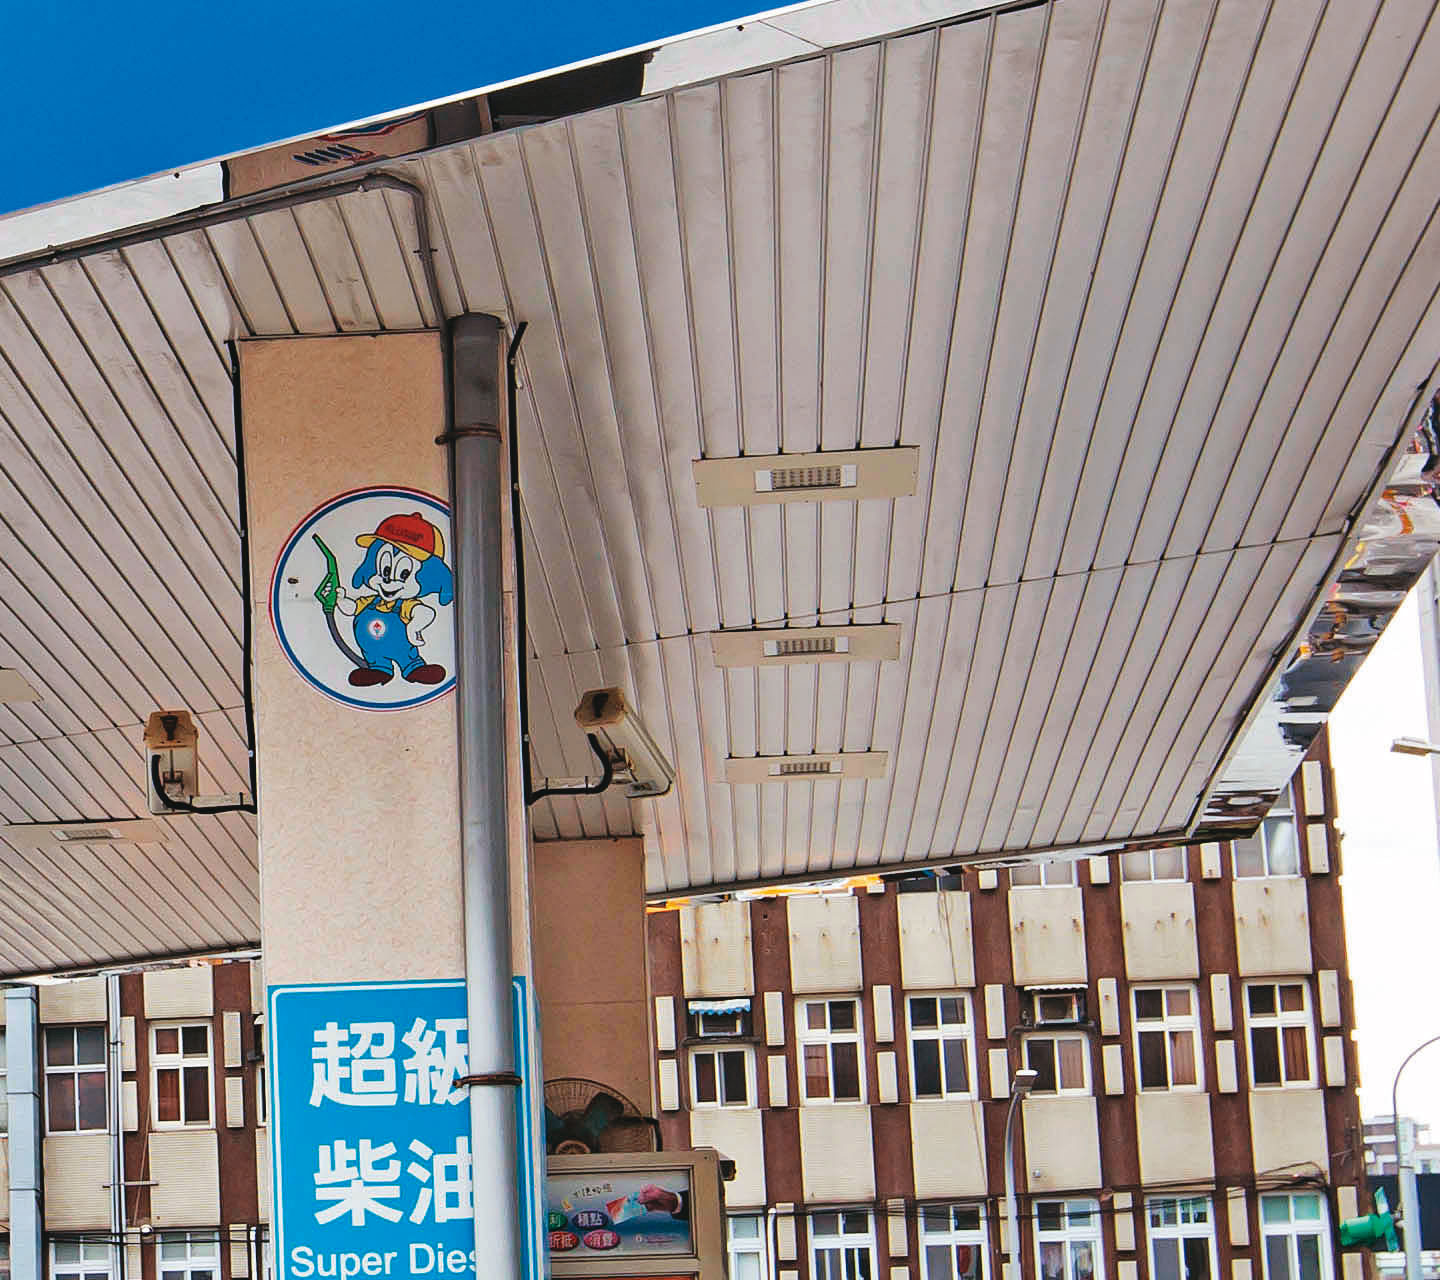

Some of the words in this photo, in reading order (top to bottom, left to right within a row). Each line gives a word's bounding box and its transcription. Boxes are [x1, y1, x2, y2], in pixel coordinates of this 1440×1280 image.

[308, 1017, 470, 1108] 超級
[313, 1135, 475, 1227] 柴油
[408, 1242, 480, 1274] Dies
